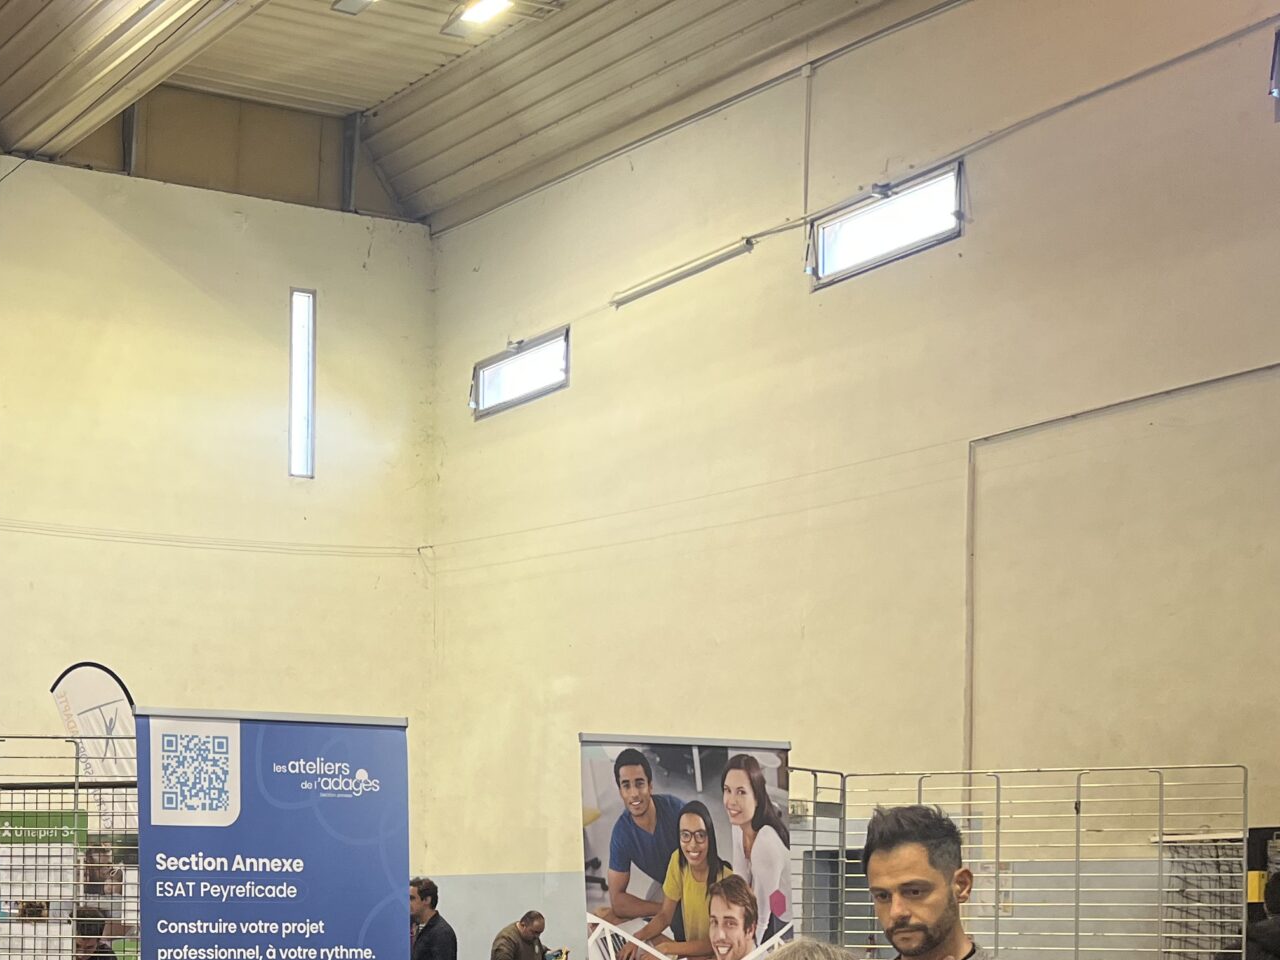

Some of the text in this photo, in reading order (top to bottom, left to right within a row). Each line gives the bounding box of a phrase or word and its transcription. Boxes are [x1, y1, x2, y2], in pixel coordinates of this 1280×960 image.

[273, 757, 350, 775] les ateliers
[301, 781, 313, 790] de
[155, 852, 304, 872] Section Annexe
[156, 882, 297, 902] ESAT Peyreficade
[157, 919, 325, 938] Construire votre projet
[266, 945, 276, 959] à
[279, 946, 317, 959] votre
